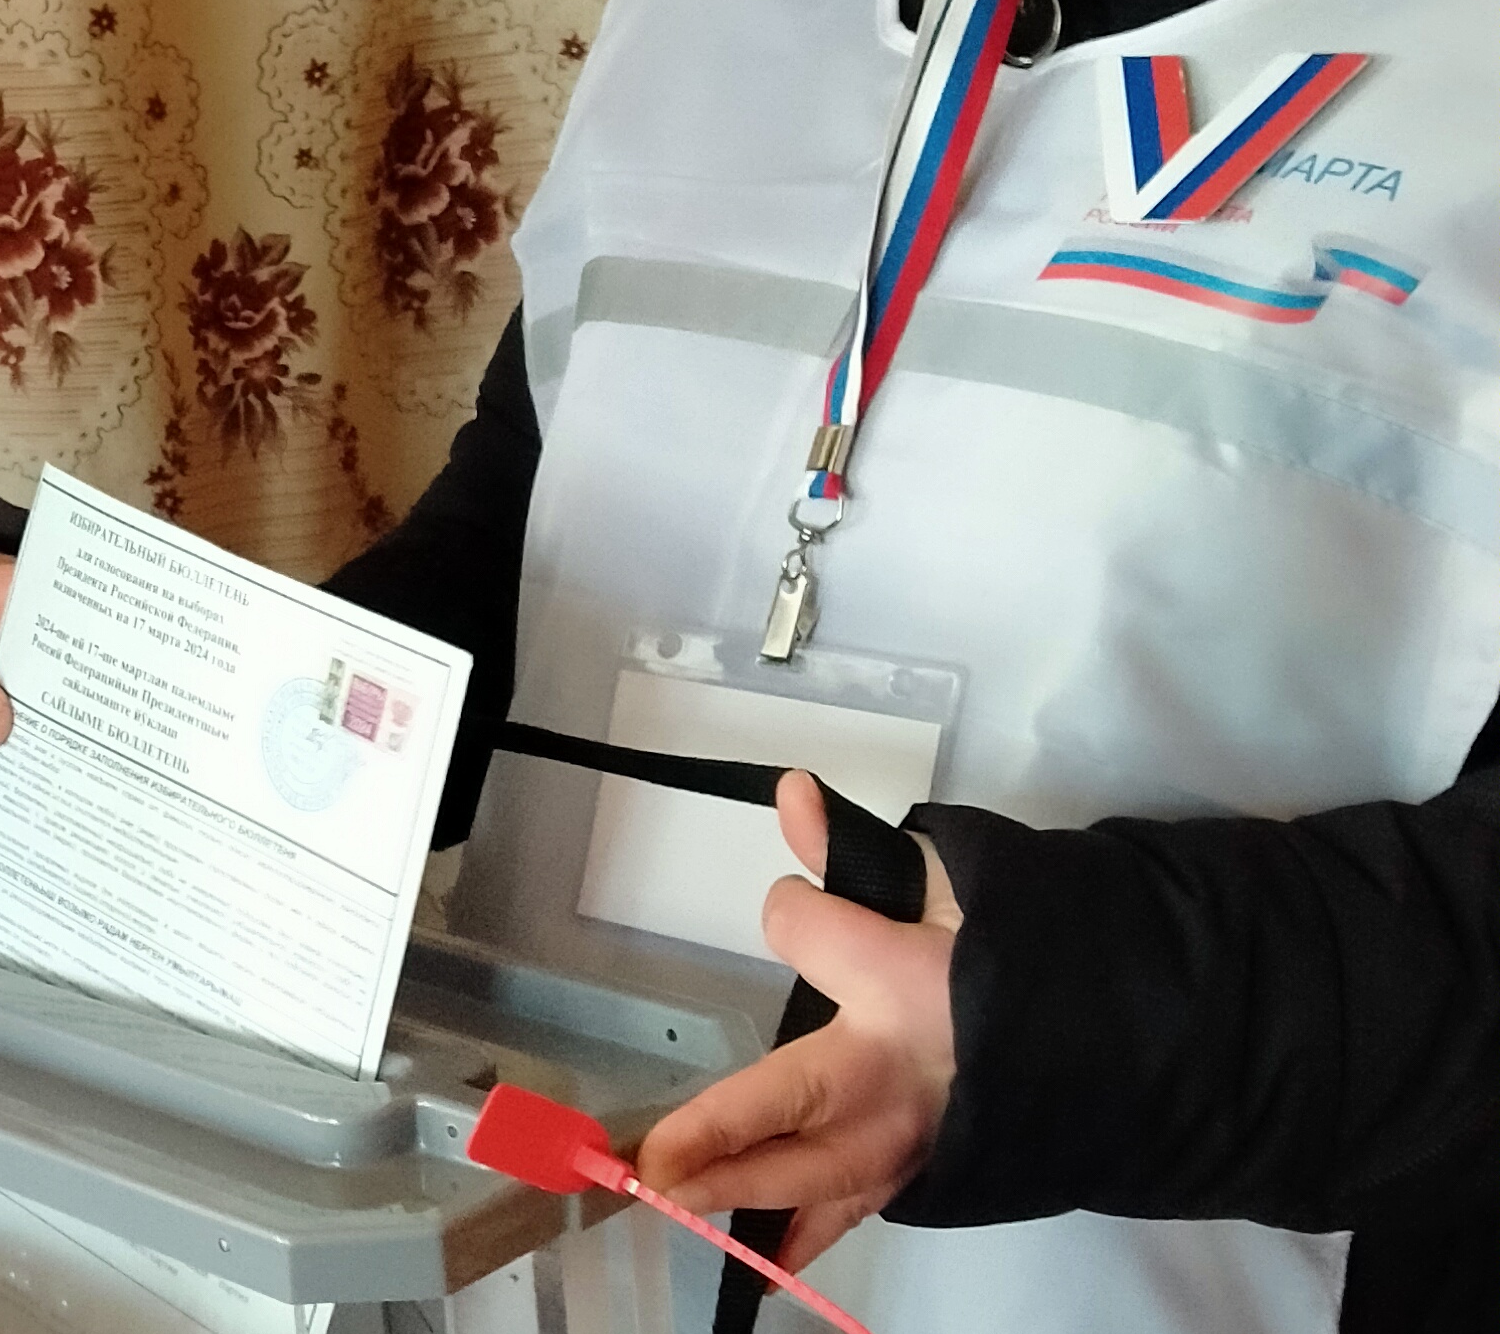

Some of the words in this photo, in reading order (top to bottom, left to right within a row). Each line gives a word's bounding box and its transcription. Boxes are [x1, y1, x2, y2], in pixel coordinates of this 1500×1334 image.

[56, 555, 107, 592] Президента
[110, 583, 173, 622] Российской
[69, 511, 166, 567] ИЗБИРАТЕЛЬНЫЙ
[168, 559, 249, 606] БЮЛЛЕТЕНЬ
[75, 547, 93, 563] для
[93, 557, 158, 594] голосования
[161, 588, 174, 601] на
[177, 595, 223, 624] выборах
[52, 579, 112, 617] назначенных
[115, 611, 129, 624] на
[132, 616, 146, 630] 17
[147, 625, 180, 648] марта
[183, 639, 209, 660] 2024
[211, 655, 235, 673] года
[40, 690, 104, 732] САЙЛЫМЕ
[107, 723, 189, 773] БЮЛЛЕТЕНЬ
